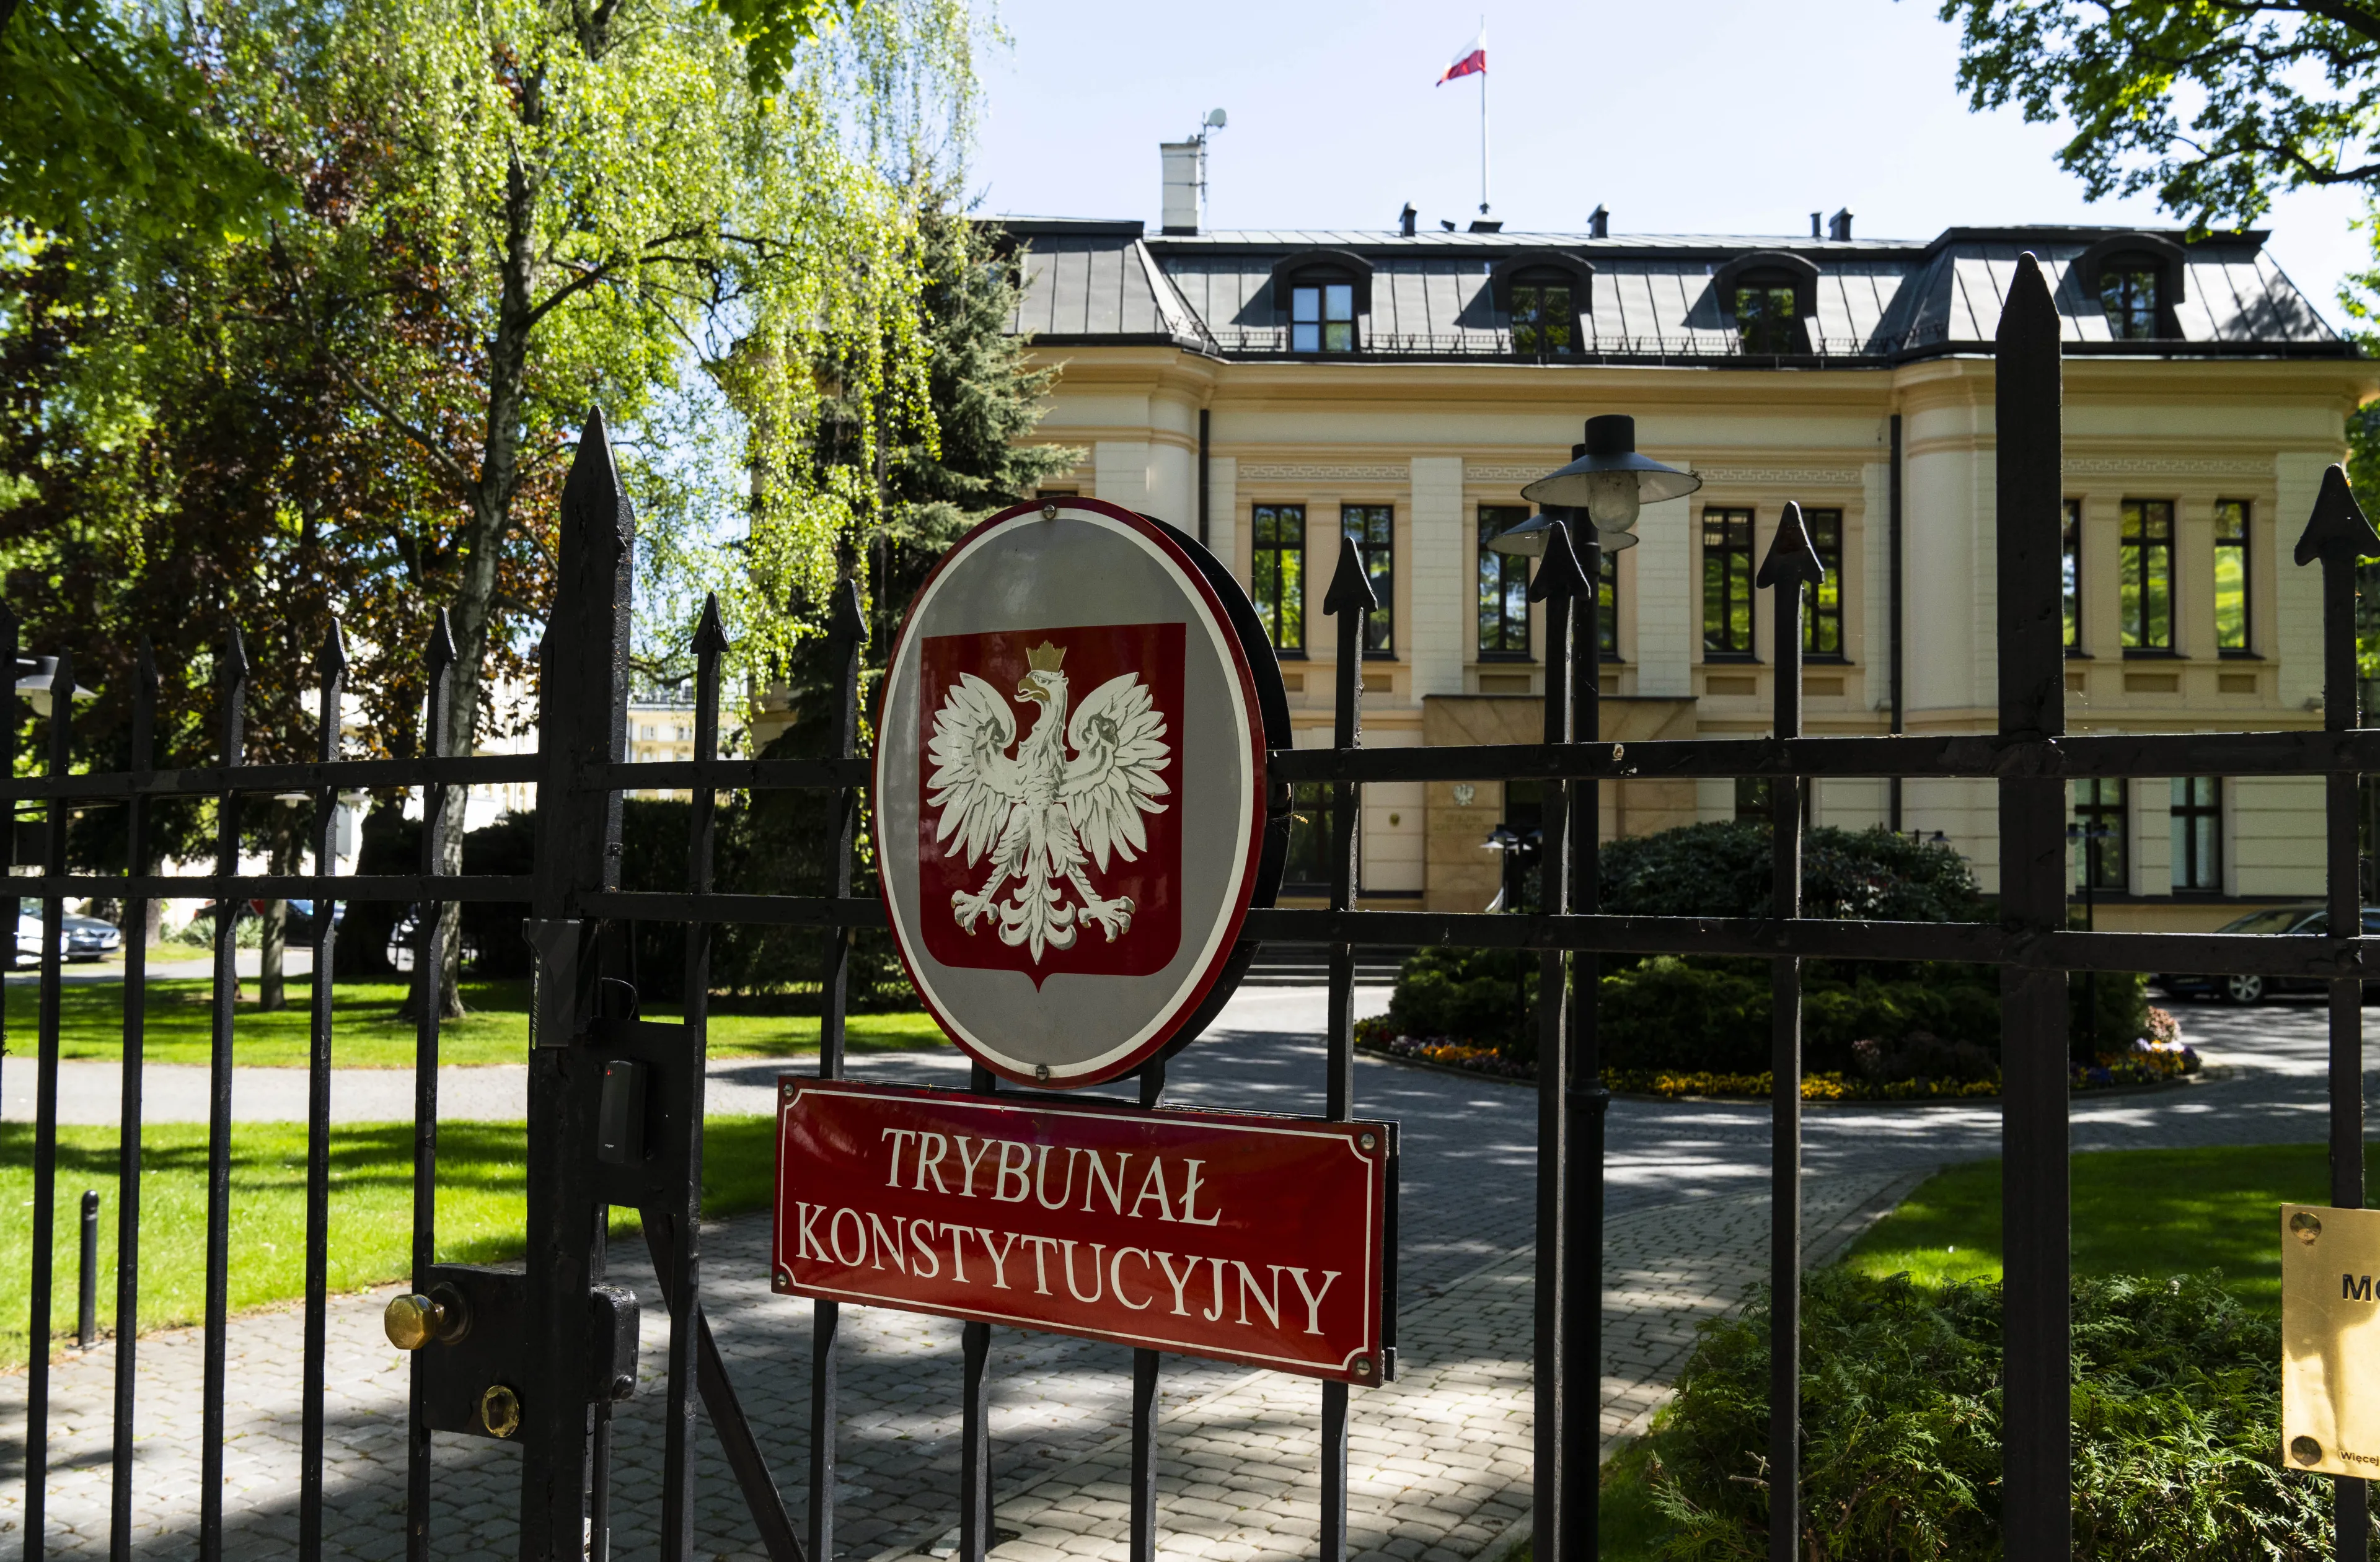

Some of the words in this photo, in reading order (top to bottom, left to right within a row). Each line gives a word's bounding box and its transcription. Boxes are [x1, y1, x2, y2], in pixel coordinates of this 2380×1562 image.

[881, 1127, 1222, 1227] TRYBUNAŁ
[795, 1201, 1342, 1336] KONSTYTUCYJNY
[2342, 1273, 2380, 1302] M
[2340, 1450, 2379, 1467] Więcej
